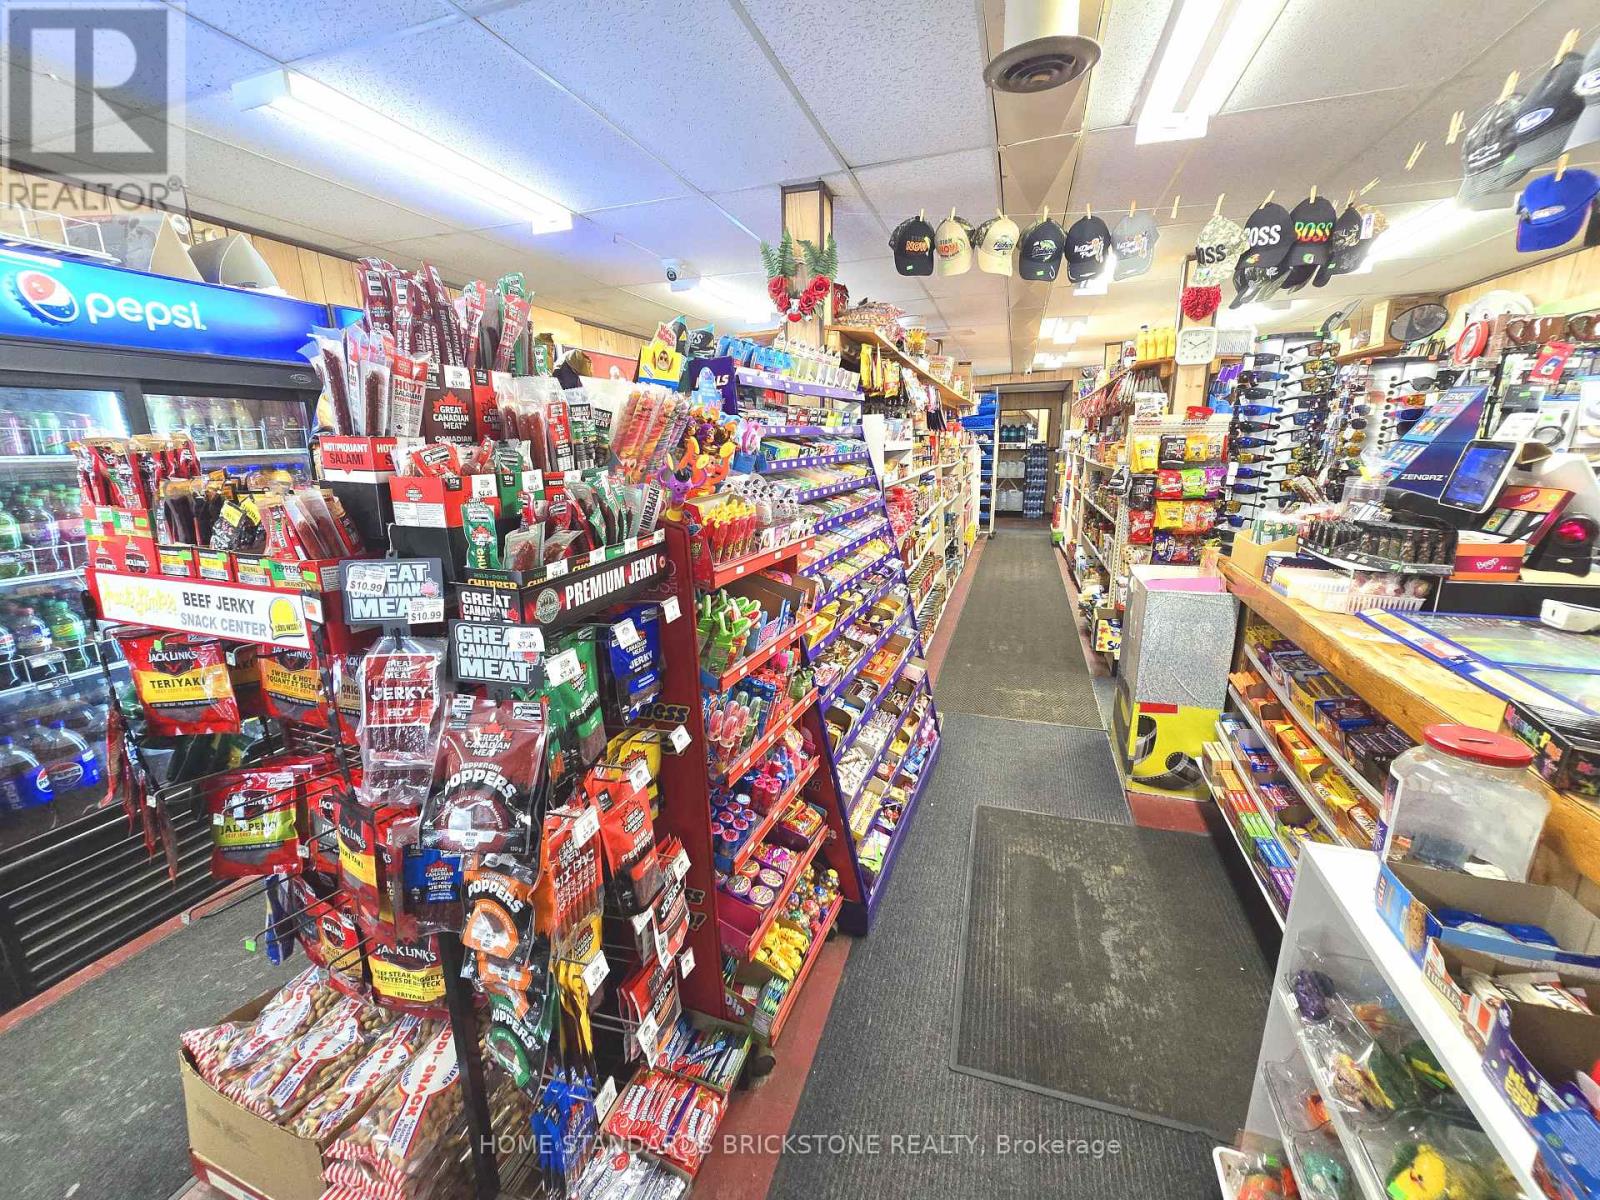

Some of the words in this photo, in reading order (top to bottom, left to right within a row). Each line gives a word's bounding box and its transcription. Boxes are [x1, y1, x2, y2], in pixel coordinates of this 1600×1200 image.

[1294, 221, 1334, 243] BOSS
[85, 292, 207, 331] pepsi
[433, 414, 469, 422] CANADIAN
[440, 405, 462, 414] GREAT
[329, 453, 364, 465] SALAMI
[350, 580, 383, 592] $10.99
[565, 569, 626, 610] PREMIUM
[628, 553, 658, 584] JERKY
[182, 591, 211, 608] BEEF
[215, 595, 256, 615] JERKY
[352, 598, 411, 618] MEA
[461, 591, 512, 608] GREAT
[180, 612, 219, 631] SNACK
[221, 617, 267, 637] CENTER
[411, 611, 441, 621] $10.99
[457, 624, 510, 645] GRE
[629, 649, 653, 670] JERKY
[460, 658, 530, 682] MEAT
[341, 683, 360, 694] ORIG
[371, 686, 428, 700] JERKY
[387, 708, 413, 717] HOT
[468, 879, 524, 913] POPPERS
